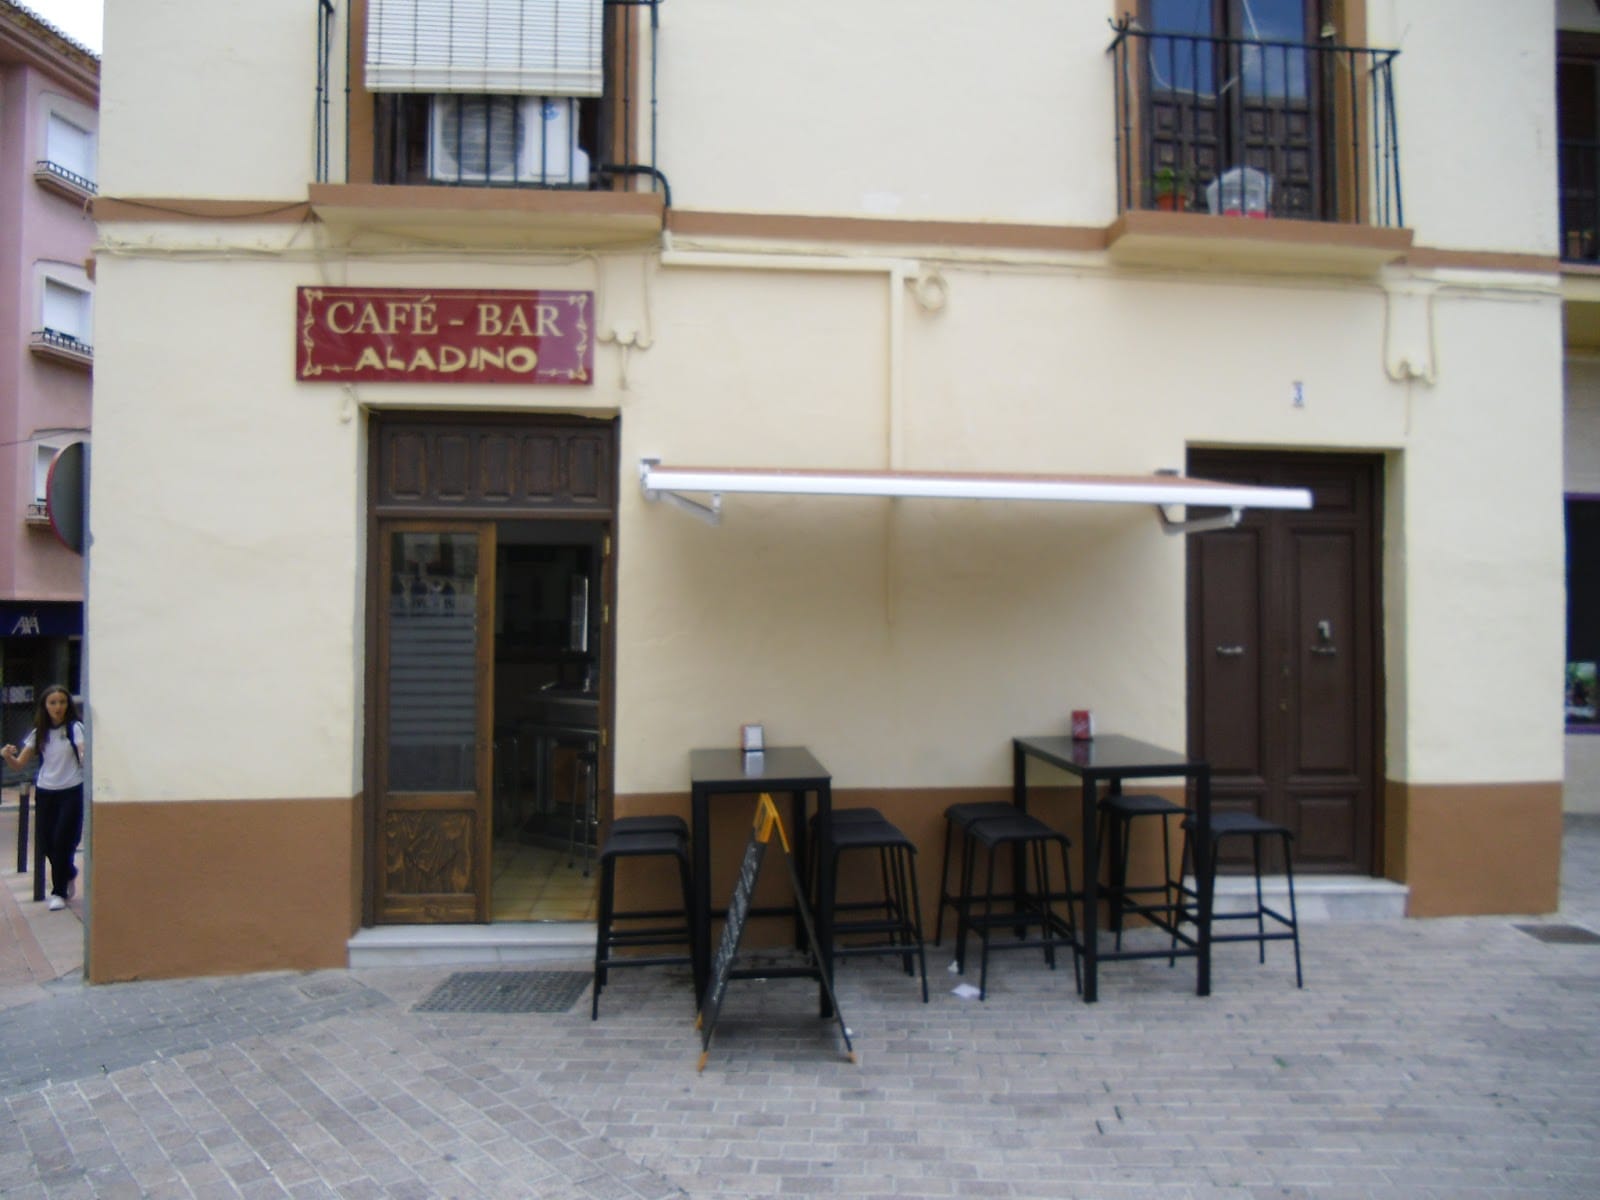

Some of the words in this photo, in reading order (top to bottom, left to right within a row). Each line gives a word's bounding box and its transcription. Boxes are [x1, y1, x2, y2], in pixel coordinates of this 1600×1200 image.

[326, 295, 439, 335] CAFÉ
[476, 303, 565, 337] BAR
[354, 345, 539, 373] ALADINO
